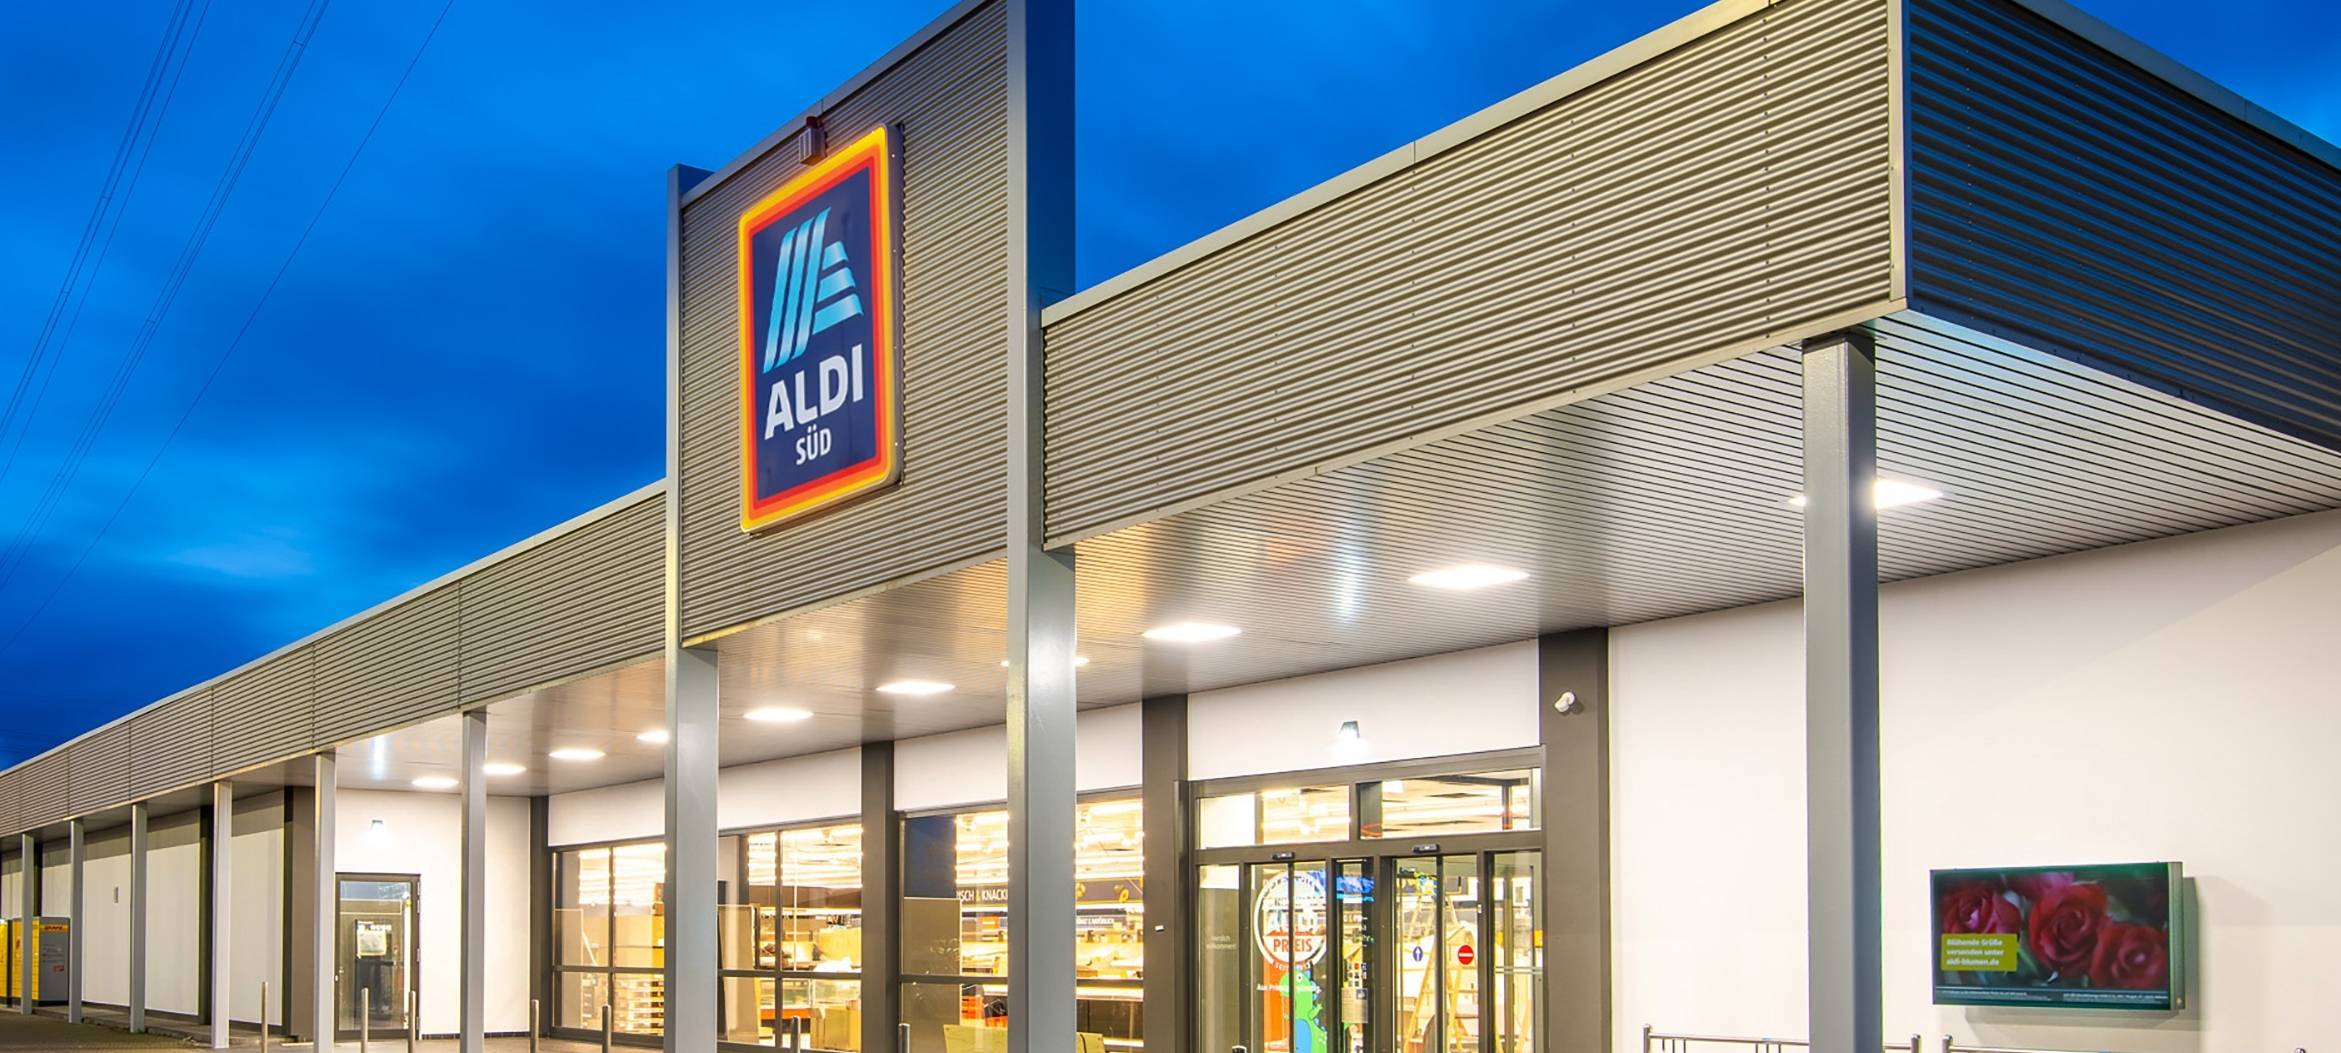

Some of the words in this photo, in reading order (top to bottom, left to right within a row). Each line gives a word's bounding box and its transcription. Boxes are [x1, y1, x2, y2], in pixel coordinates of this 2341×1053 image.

[764, 343, 863, 440] ALDI
[795, 423, 832, 465] SÜD
[1273, 938, 1313, 952] PREIS
[1946, 948, 1983, 956] versenden
